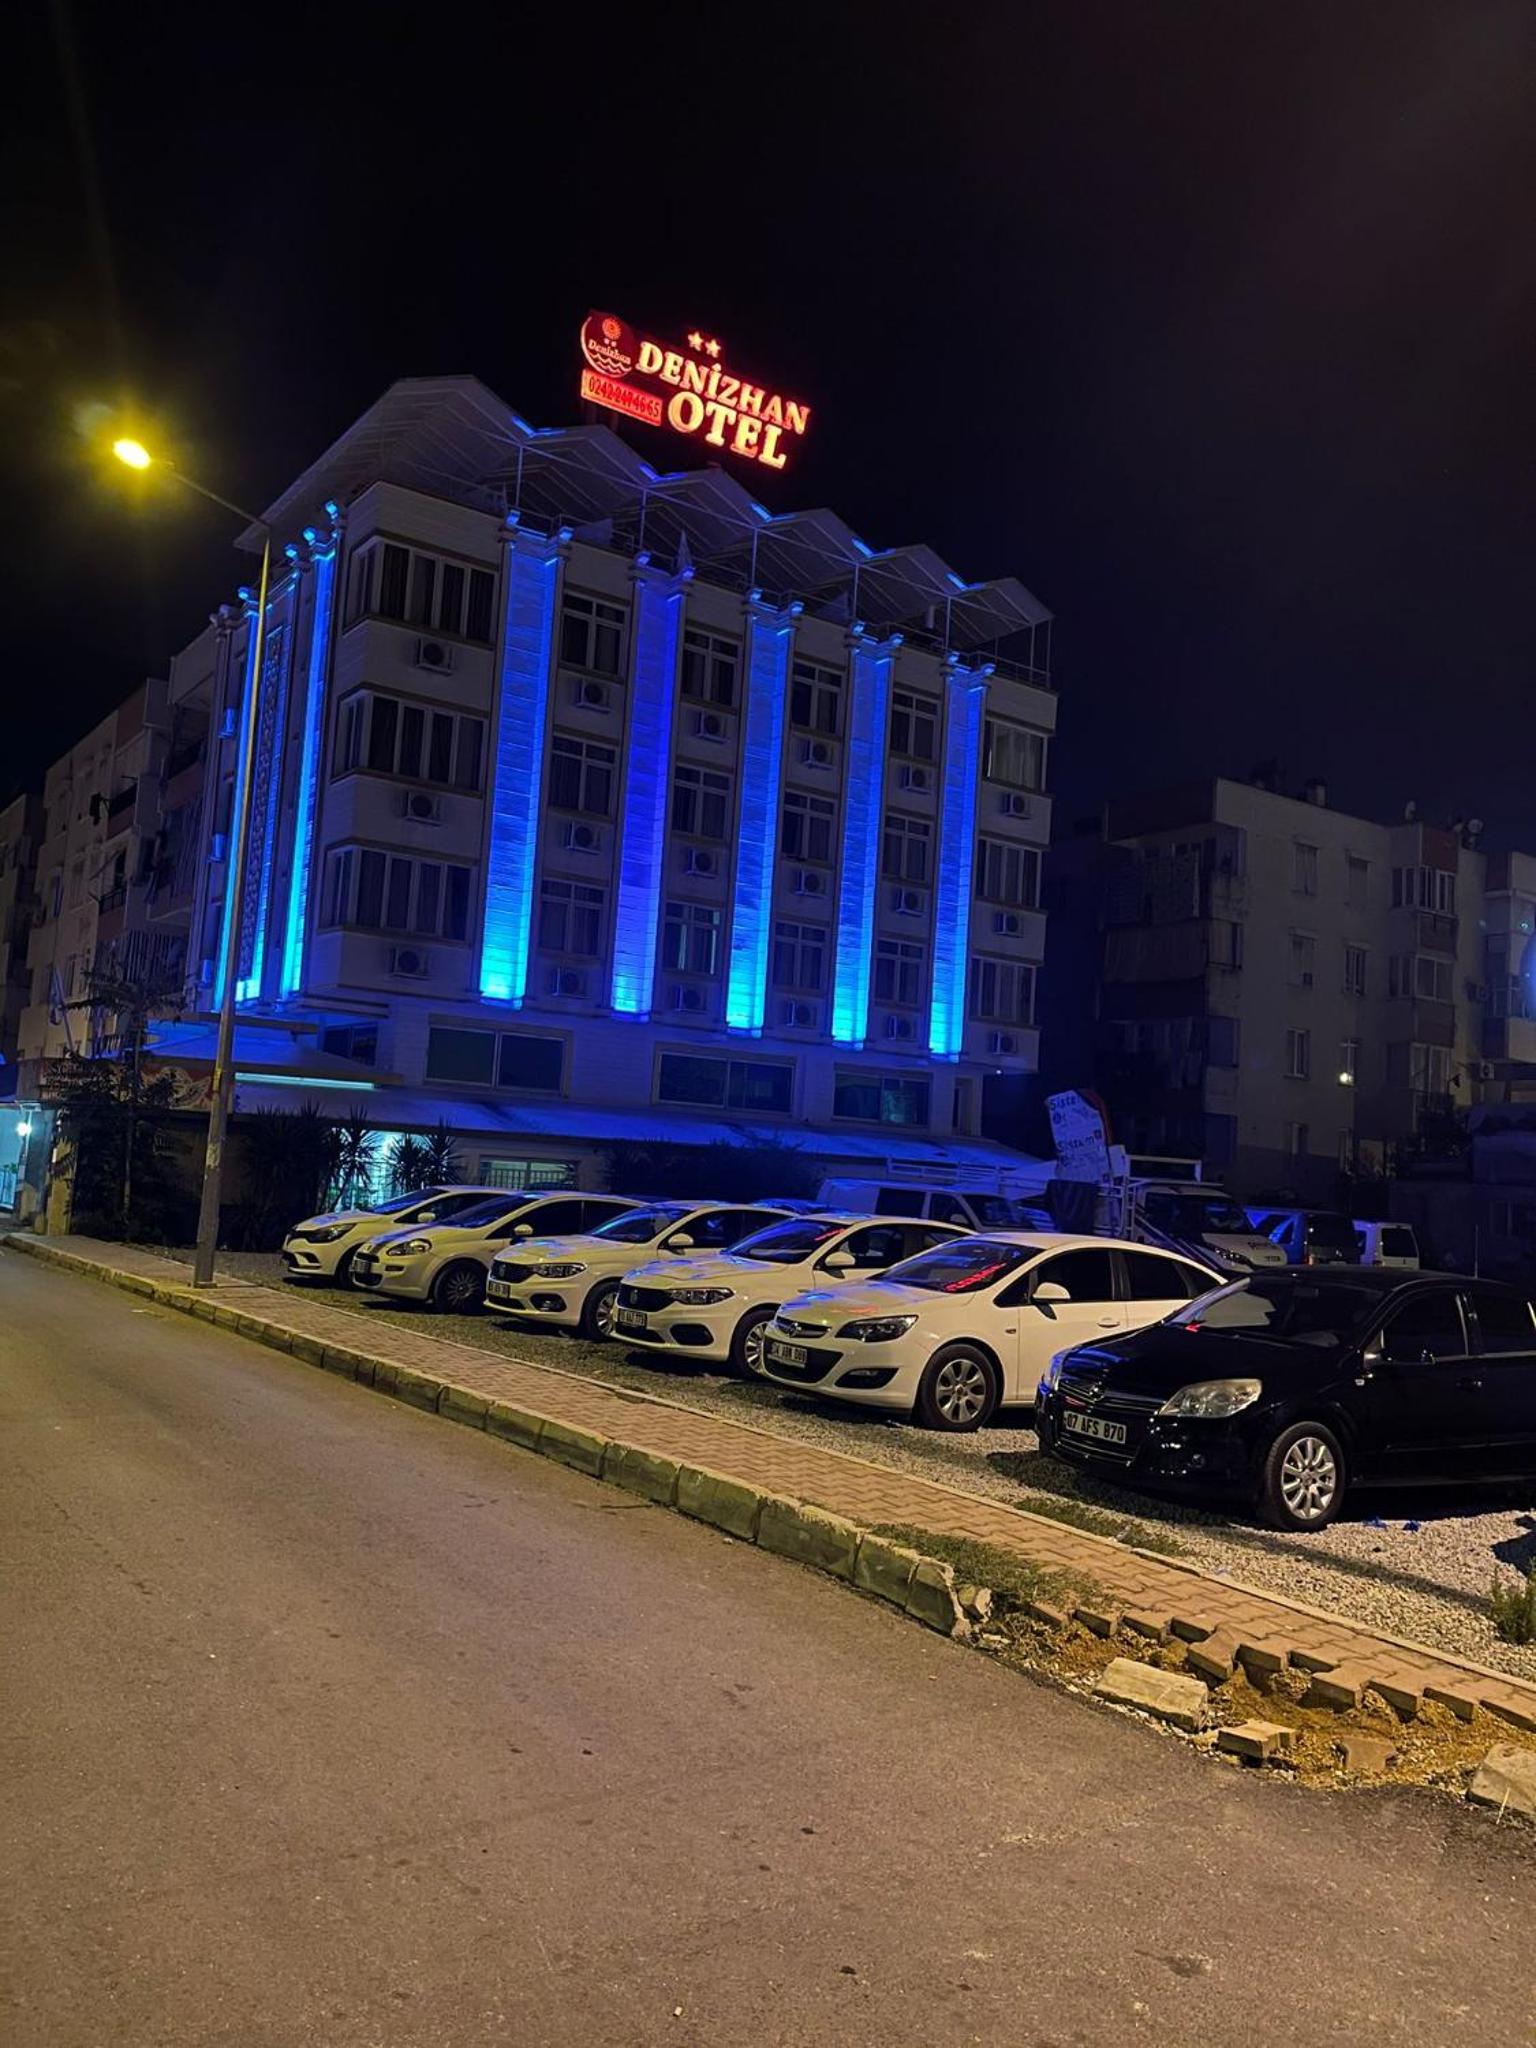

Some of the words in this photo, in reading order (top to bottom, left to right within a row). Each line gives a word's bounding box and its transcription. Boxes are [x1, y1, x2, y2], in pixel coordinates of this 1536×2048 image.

[635, 341, 811, 435] DENİZHAN
[667, 391, 787, 470] OTEL
[1081, 1418, 1099, 1435] AFS
[1104, 1423, 1124, 1441] 870
